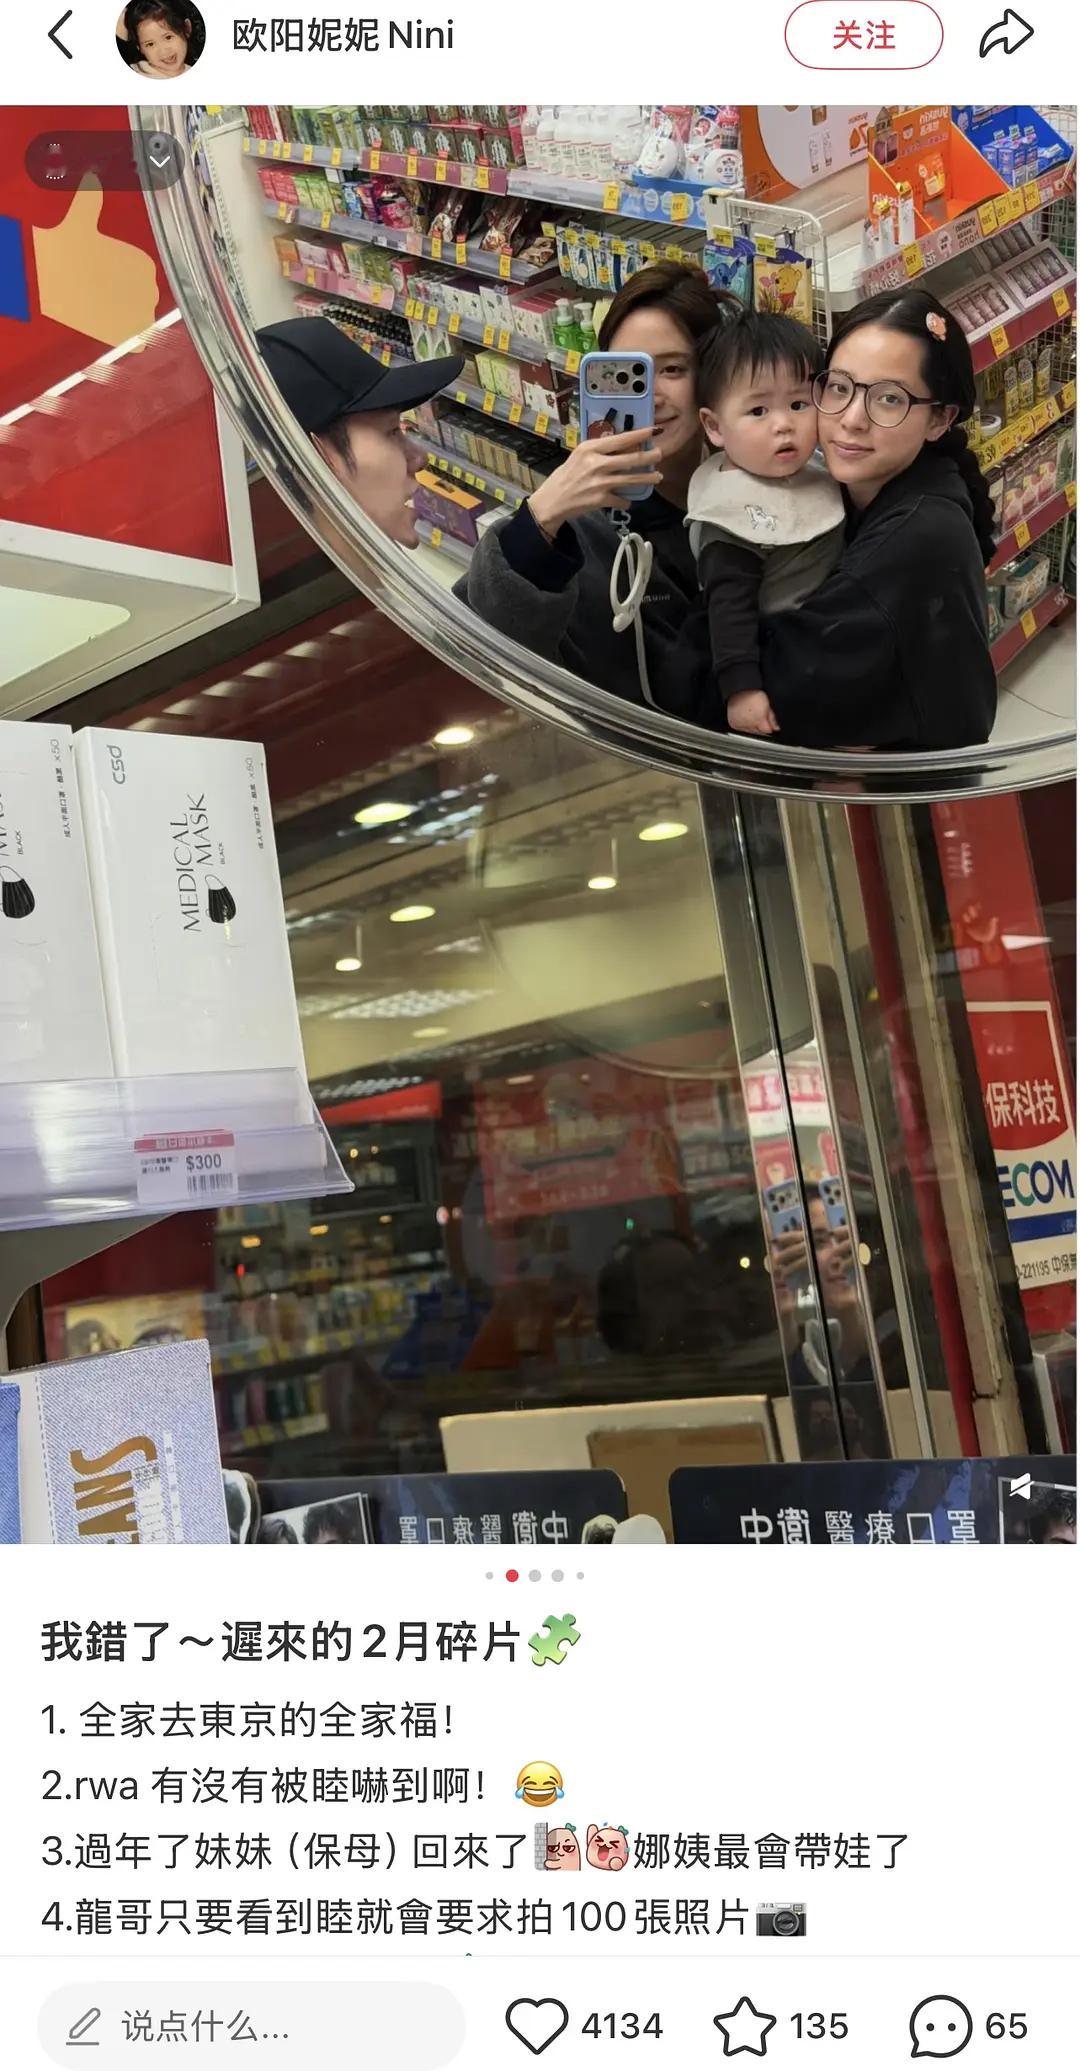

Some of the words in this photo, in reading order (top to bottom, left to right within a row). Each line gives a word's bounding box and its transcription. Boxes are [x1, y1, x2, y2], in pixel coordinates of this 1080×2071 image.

[106, 744, 126, 785] csd
[187, 793, 213, 867] MASK
[171, 812, 201, 933] MEDICAL
[985, 1078, 1061, 1128] 保科技
[186, 1154, 222, 1172] $300
